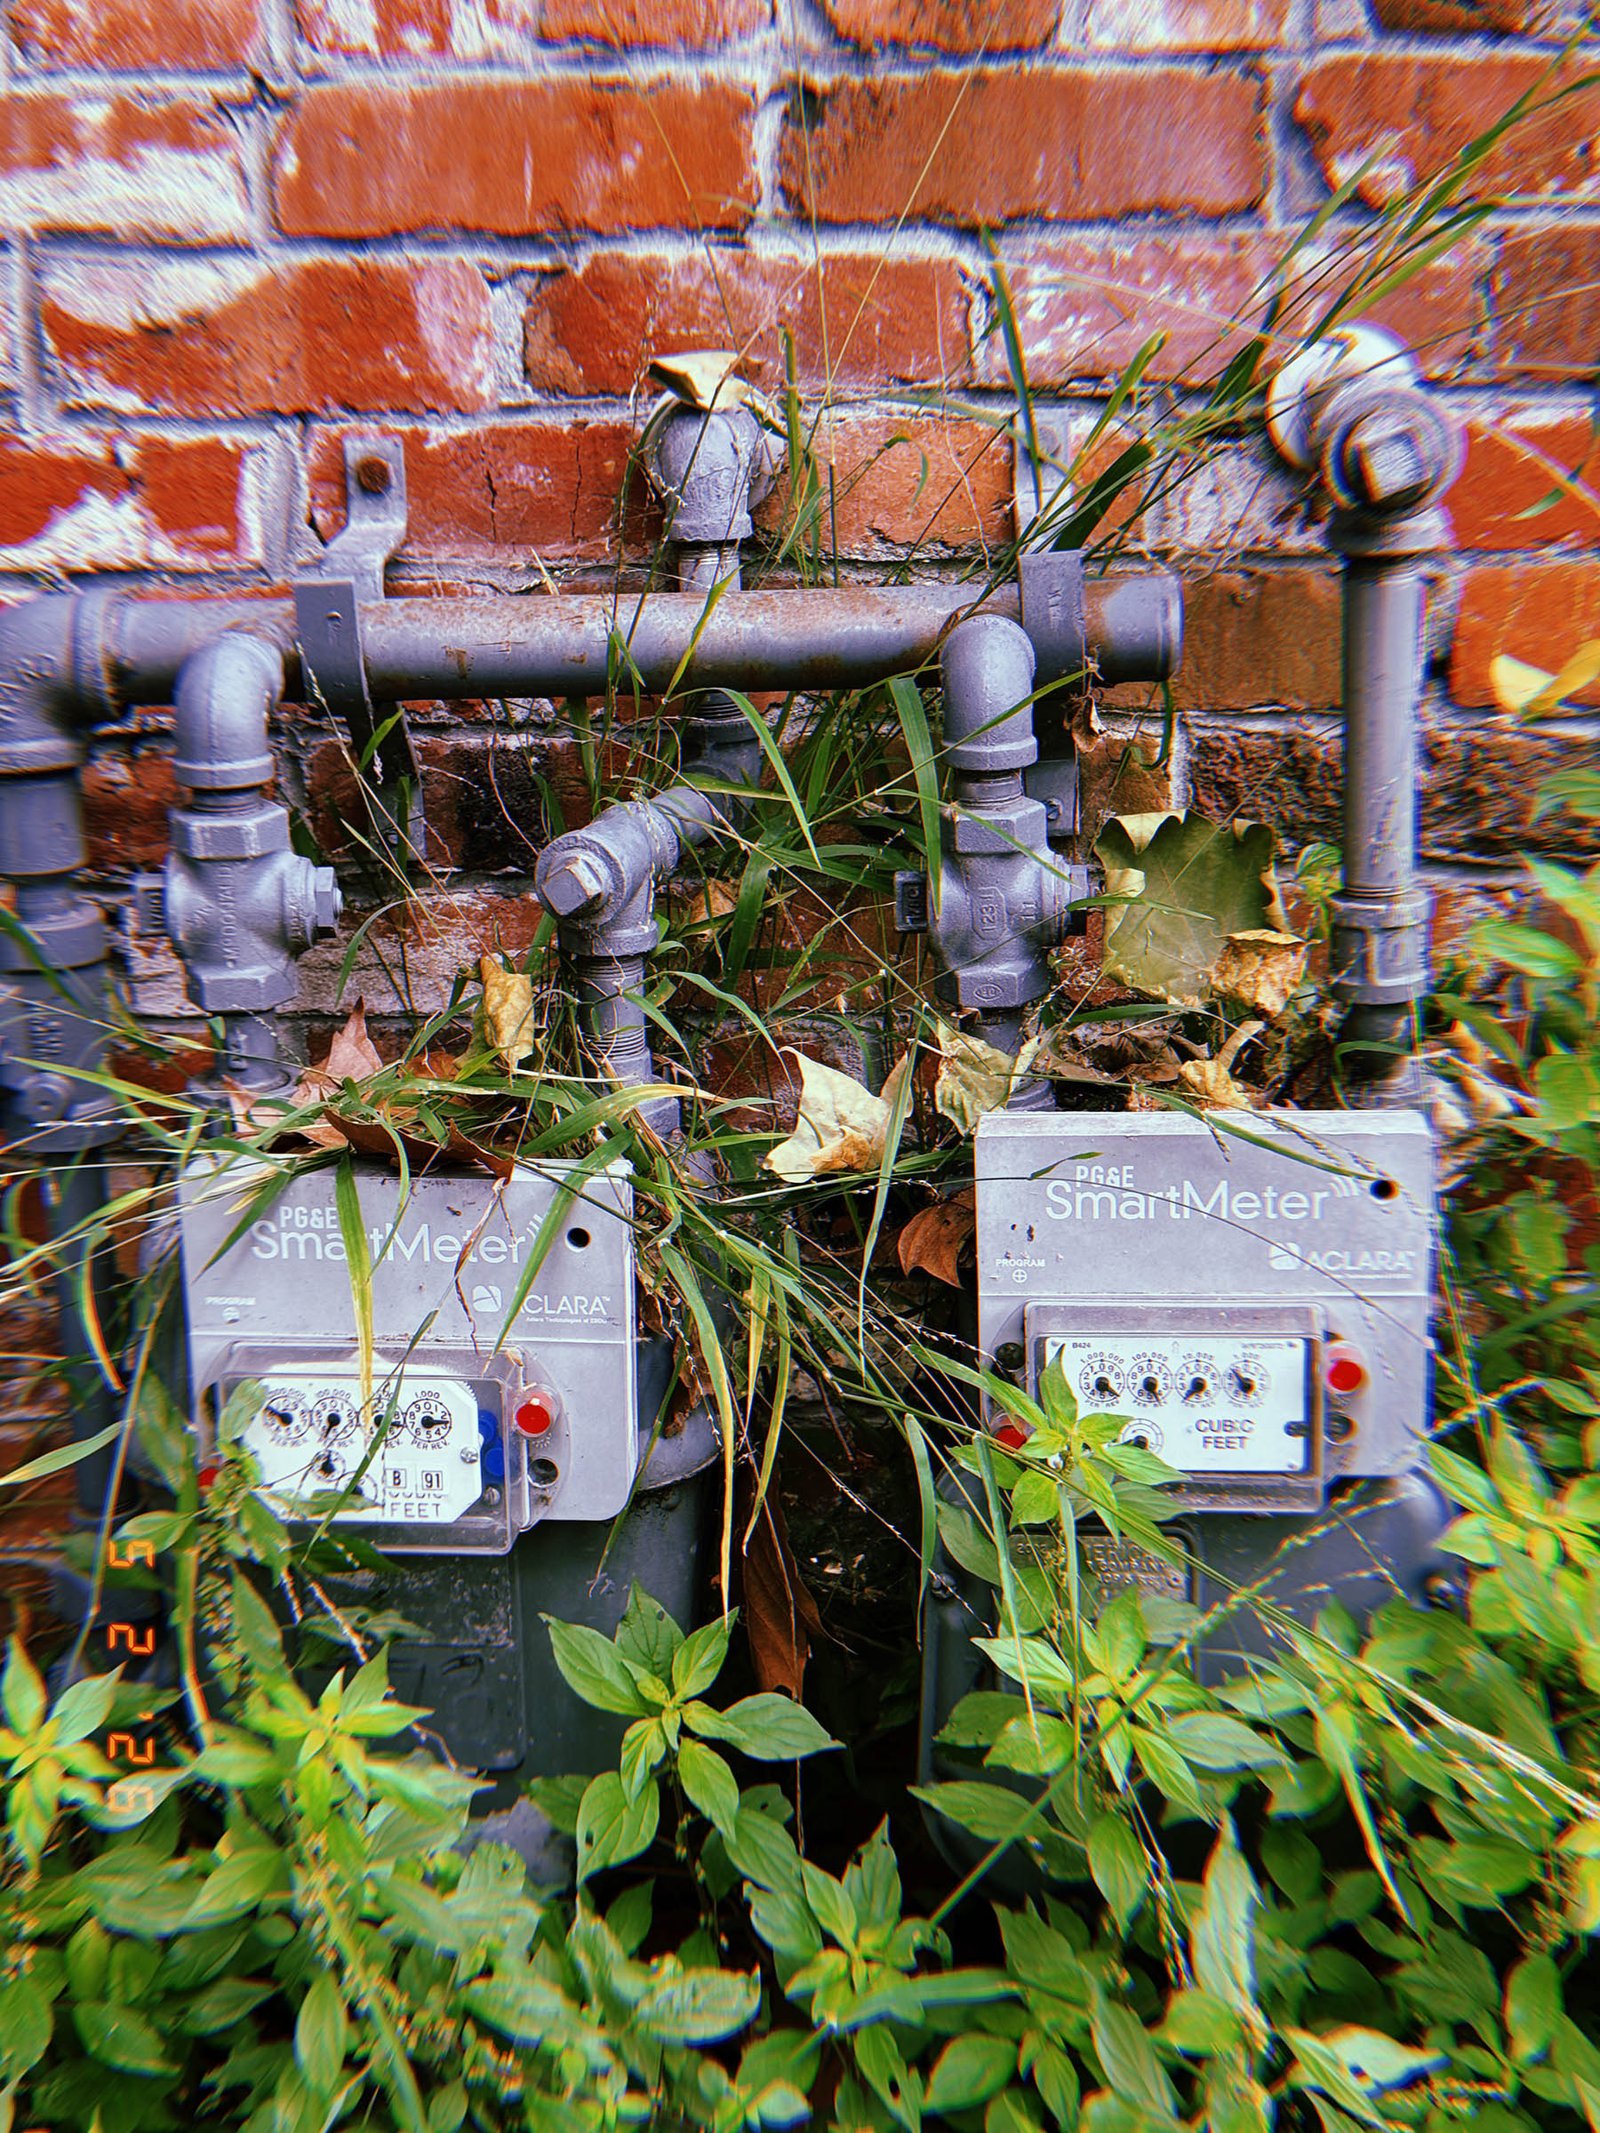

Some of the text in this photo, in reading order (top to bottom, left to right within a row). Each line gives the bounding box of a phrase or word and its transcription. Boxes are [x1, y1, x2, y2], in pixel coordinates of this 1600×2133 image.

[1075, 1165, 1135, 1188] PG&E
[1045, 1180, 1328, 1220] SmartMeter
[279, 1205, 338, 1229] PG&E
[250, 1220, 526, 1264] SmatMeter
[995, 1258, 1046, 1267] PROGRAM
[415, 1390, 440, 1399] 1,000
[415, 1404, 421, 1412] 9
[424, 1402, 431, 1410] 0
[409, 1411, 415, 1420] 8
[409, 1421, 415, 1429] 7
[1195, 1418, 1256, 1433] CUBIC
[415, 1428, 421, 1436] 6
[426, 1431, 432, 1439] 5
[410, 1440, 428, 1451] PER
[1202, 1435, 1249, 1450] FEET
[392, 1470, 402, 1487] B
[424, 1472, 441, 1489] 91
[390, 1502, 441, 1518] FEET
